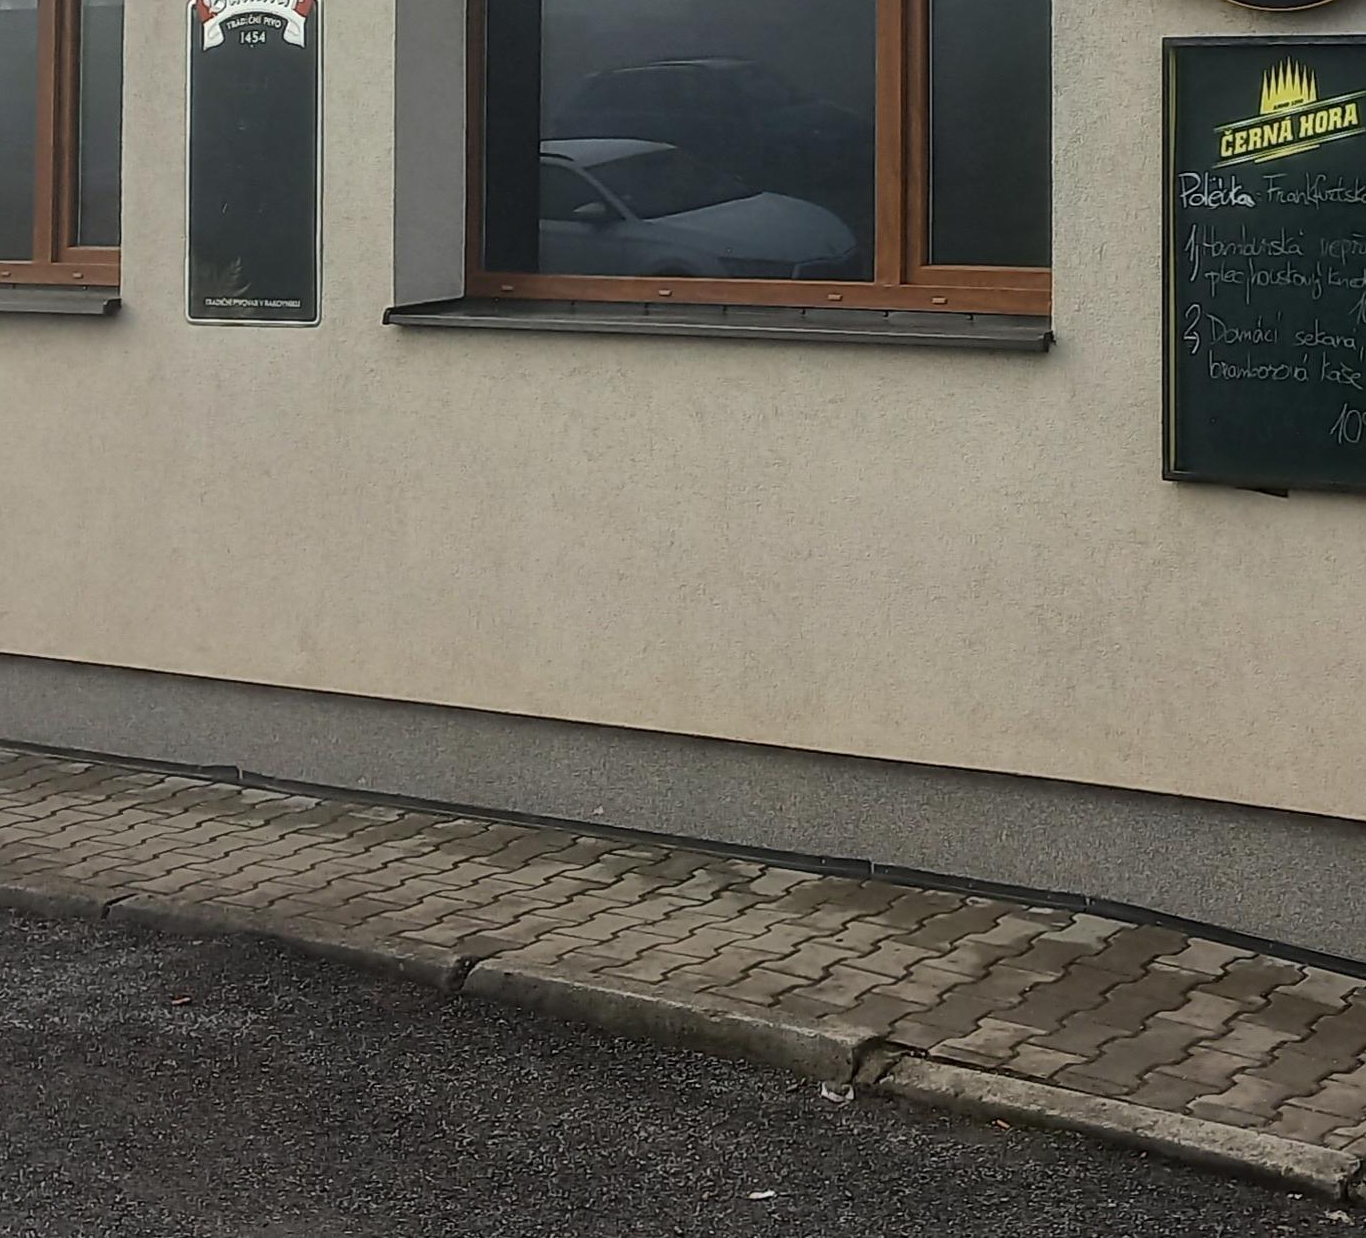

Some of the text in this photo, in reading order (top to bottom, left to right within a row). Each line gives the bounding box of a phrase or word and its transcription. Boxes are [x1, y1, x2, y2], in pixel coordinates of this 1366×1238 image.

[239, 30, 267, 44] 1454
[1220, 102, 1359, 158] ČERNÁ HORA
